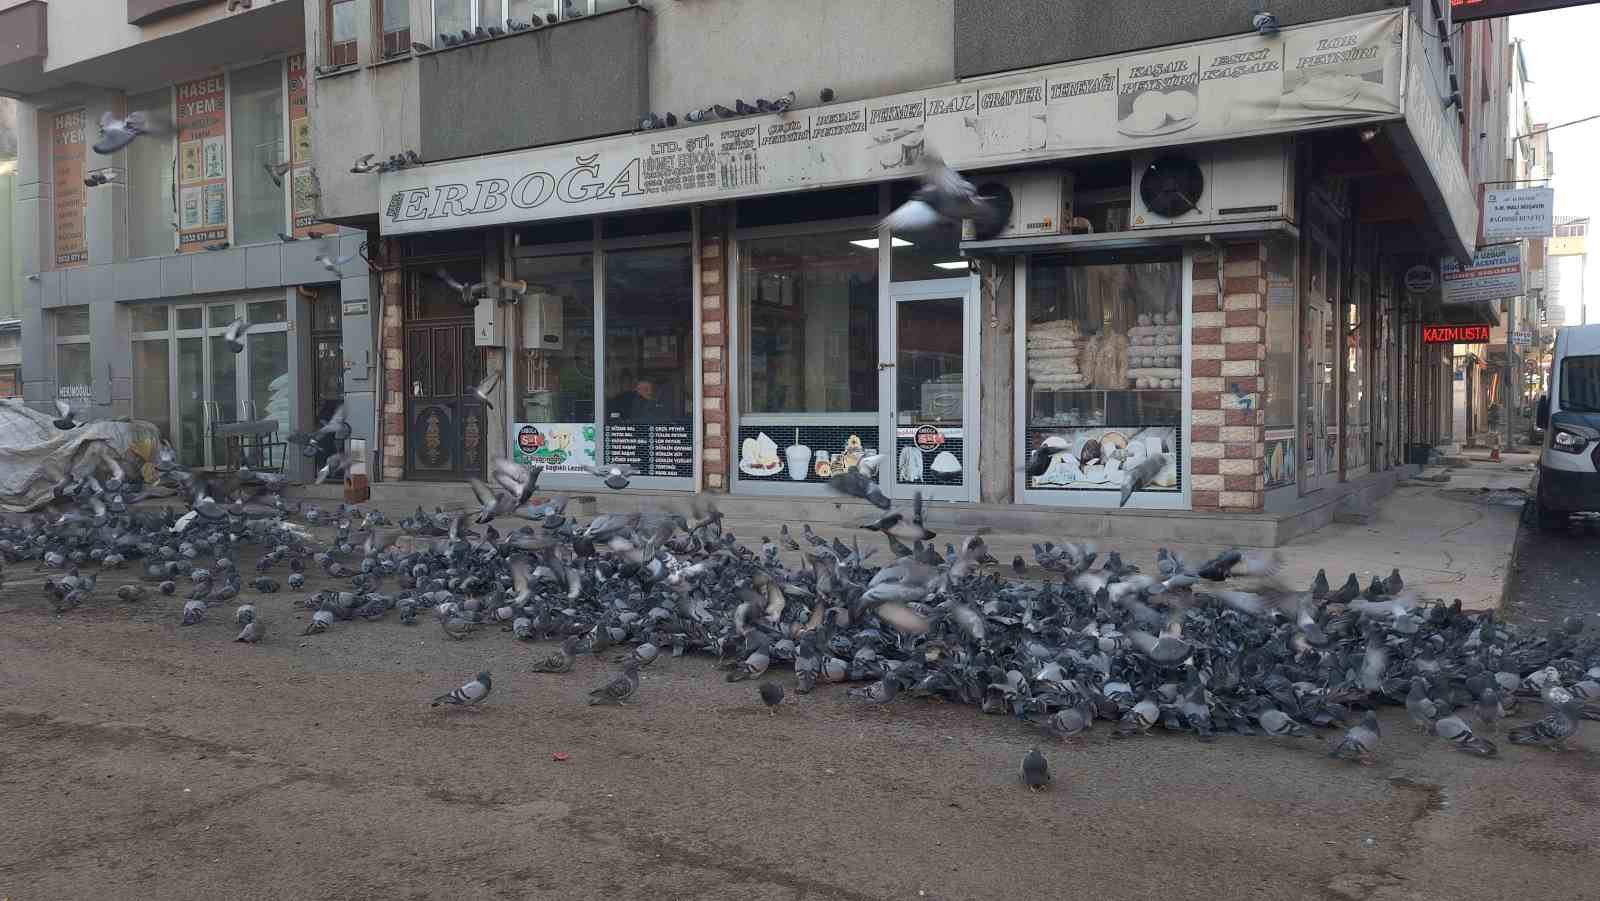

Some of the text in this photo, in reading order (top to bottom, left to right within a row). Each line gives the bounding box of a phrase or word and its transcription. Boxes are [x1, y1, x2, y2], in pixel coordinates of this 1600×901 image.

[927, 95, 976, 116] BAL
[392, 153, 645, 223] ERBOĞA
[1423, 326, 1489, 342] KAZIM USTA
